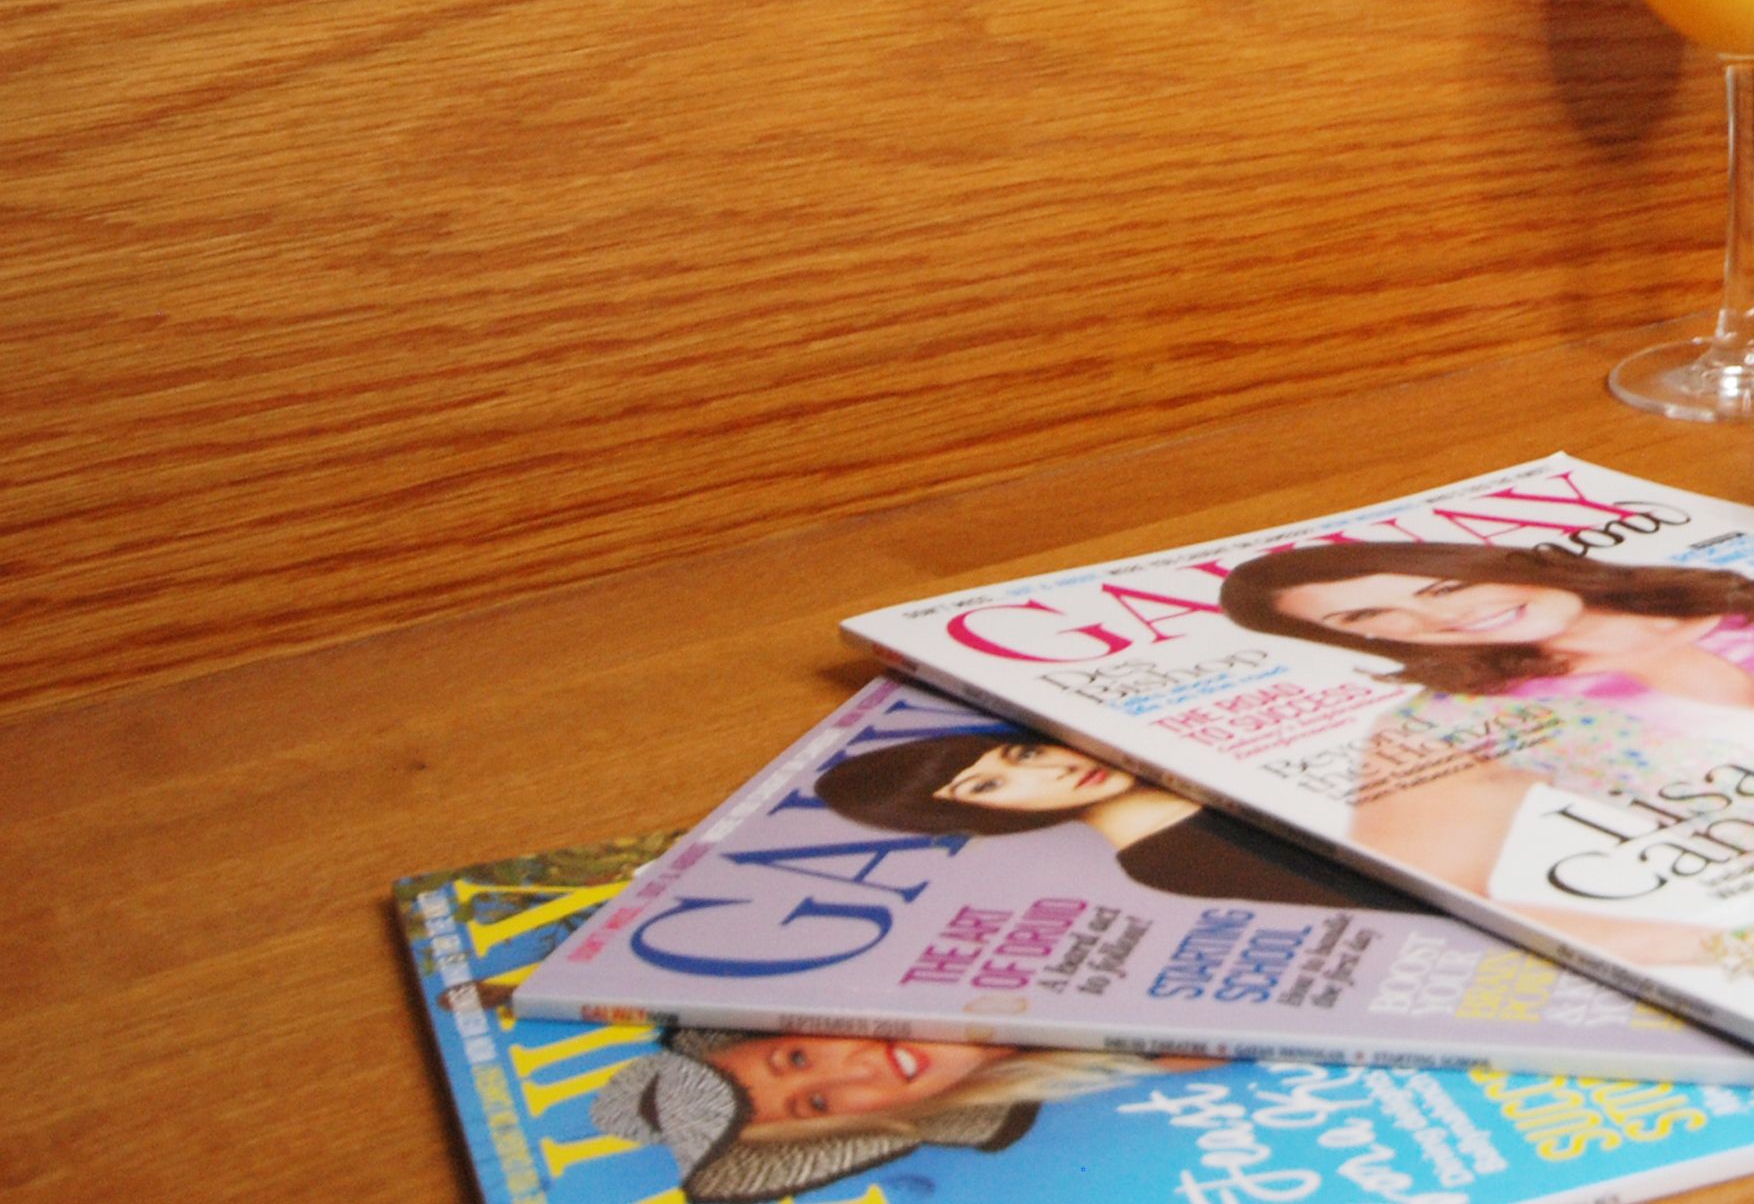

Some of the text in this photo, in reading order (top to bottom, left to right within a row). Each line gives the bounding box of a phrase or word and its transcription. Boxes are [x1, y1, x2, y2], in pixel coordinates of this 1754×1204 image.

[946, 472, 1640, 663] GAAY
[1147, 681, 1311, 732] THE ROAD
[1180, 681, 1382, 745] TO SUCCESS
[894, 905, 1018, 986] THE ART
[963, 896, 1096, 990] OF DRUID
[1139, 906, 1262, 999] STARTING
[1207, 921, 1316, 1004] SCHOOL
[1576, 1077, 1708, 1142] STO
